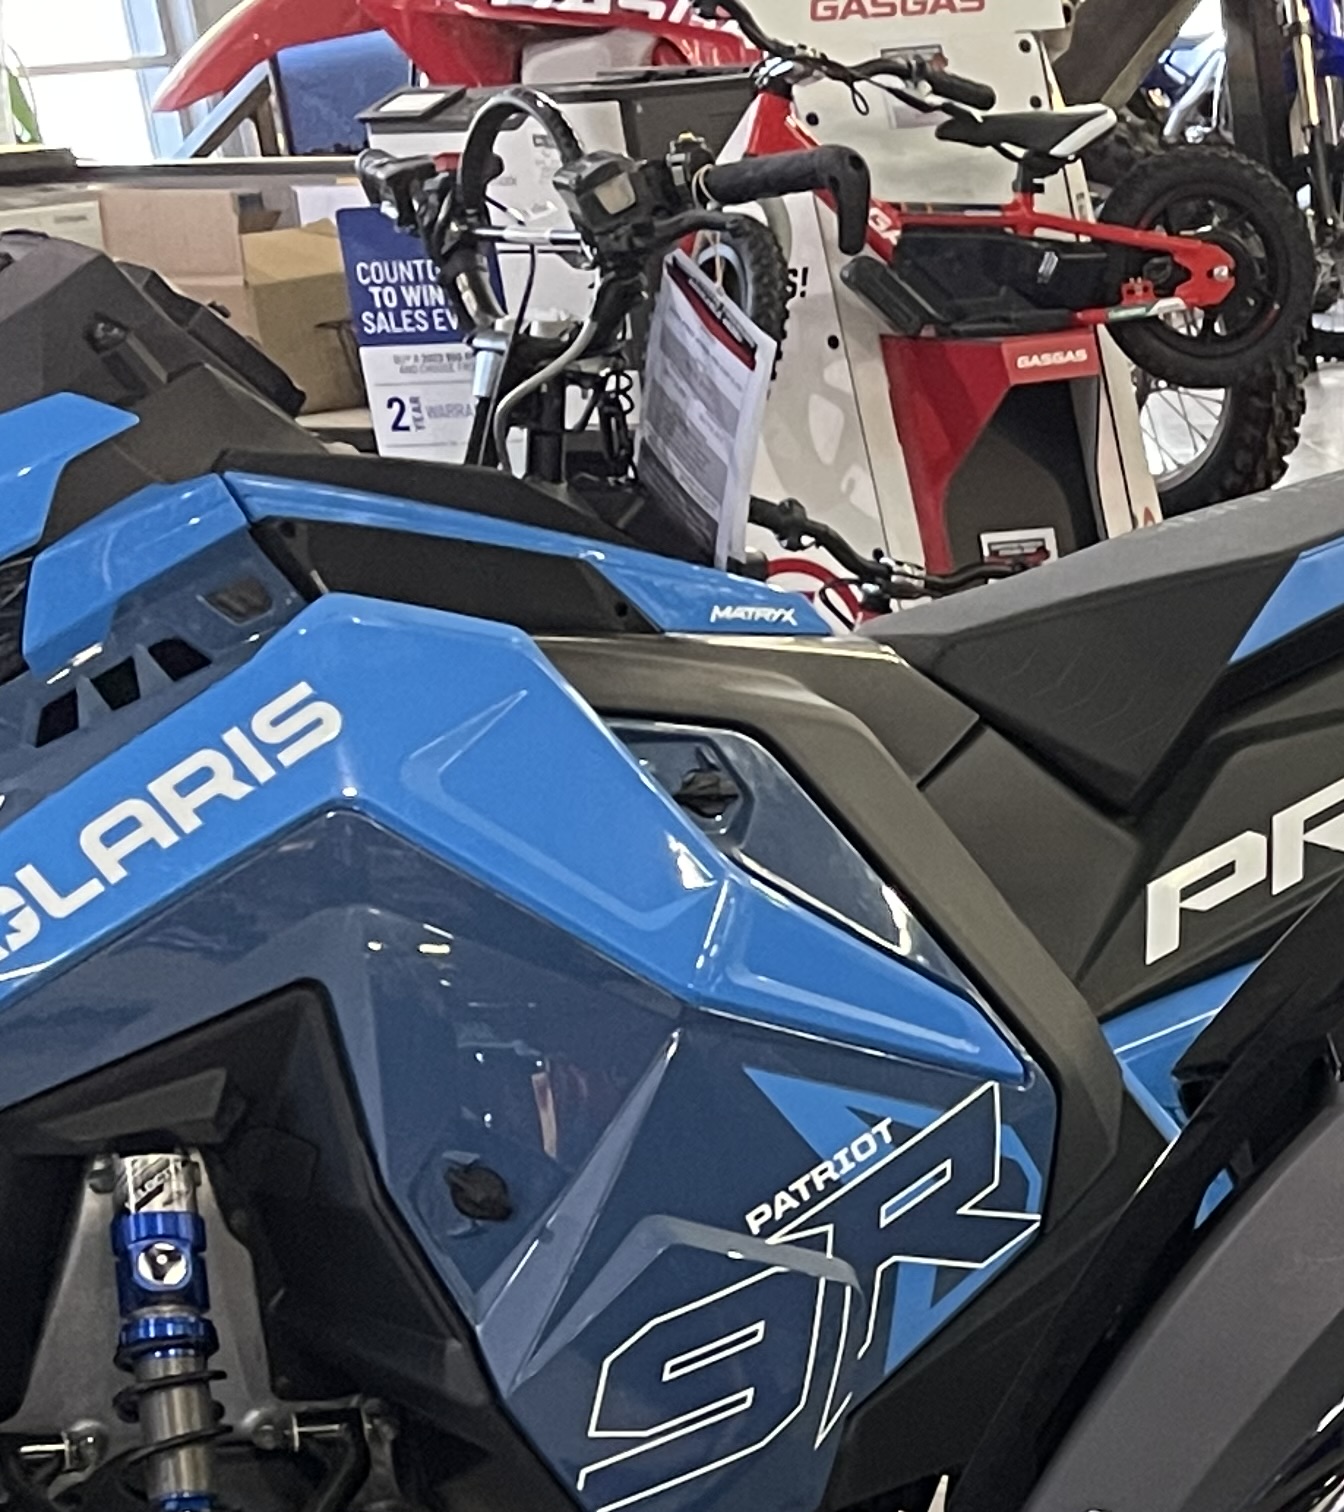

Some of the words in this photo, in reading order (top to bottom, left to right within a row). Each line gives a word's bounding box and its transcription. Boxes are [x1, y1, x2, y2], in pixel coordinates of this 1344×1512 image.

[809, 0, 986, 22] GASGAS
[368, 286, 398, 309] TO
[361, 310, 429, 335] SALES
[1016, 348, 1089, 369] GASGAS
[386, 397, 411, 432] 2
[710, 604, 799, 627] MATRYX
[744, 1117, 894, 1235] PATRIOT
